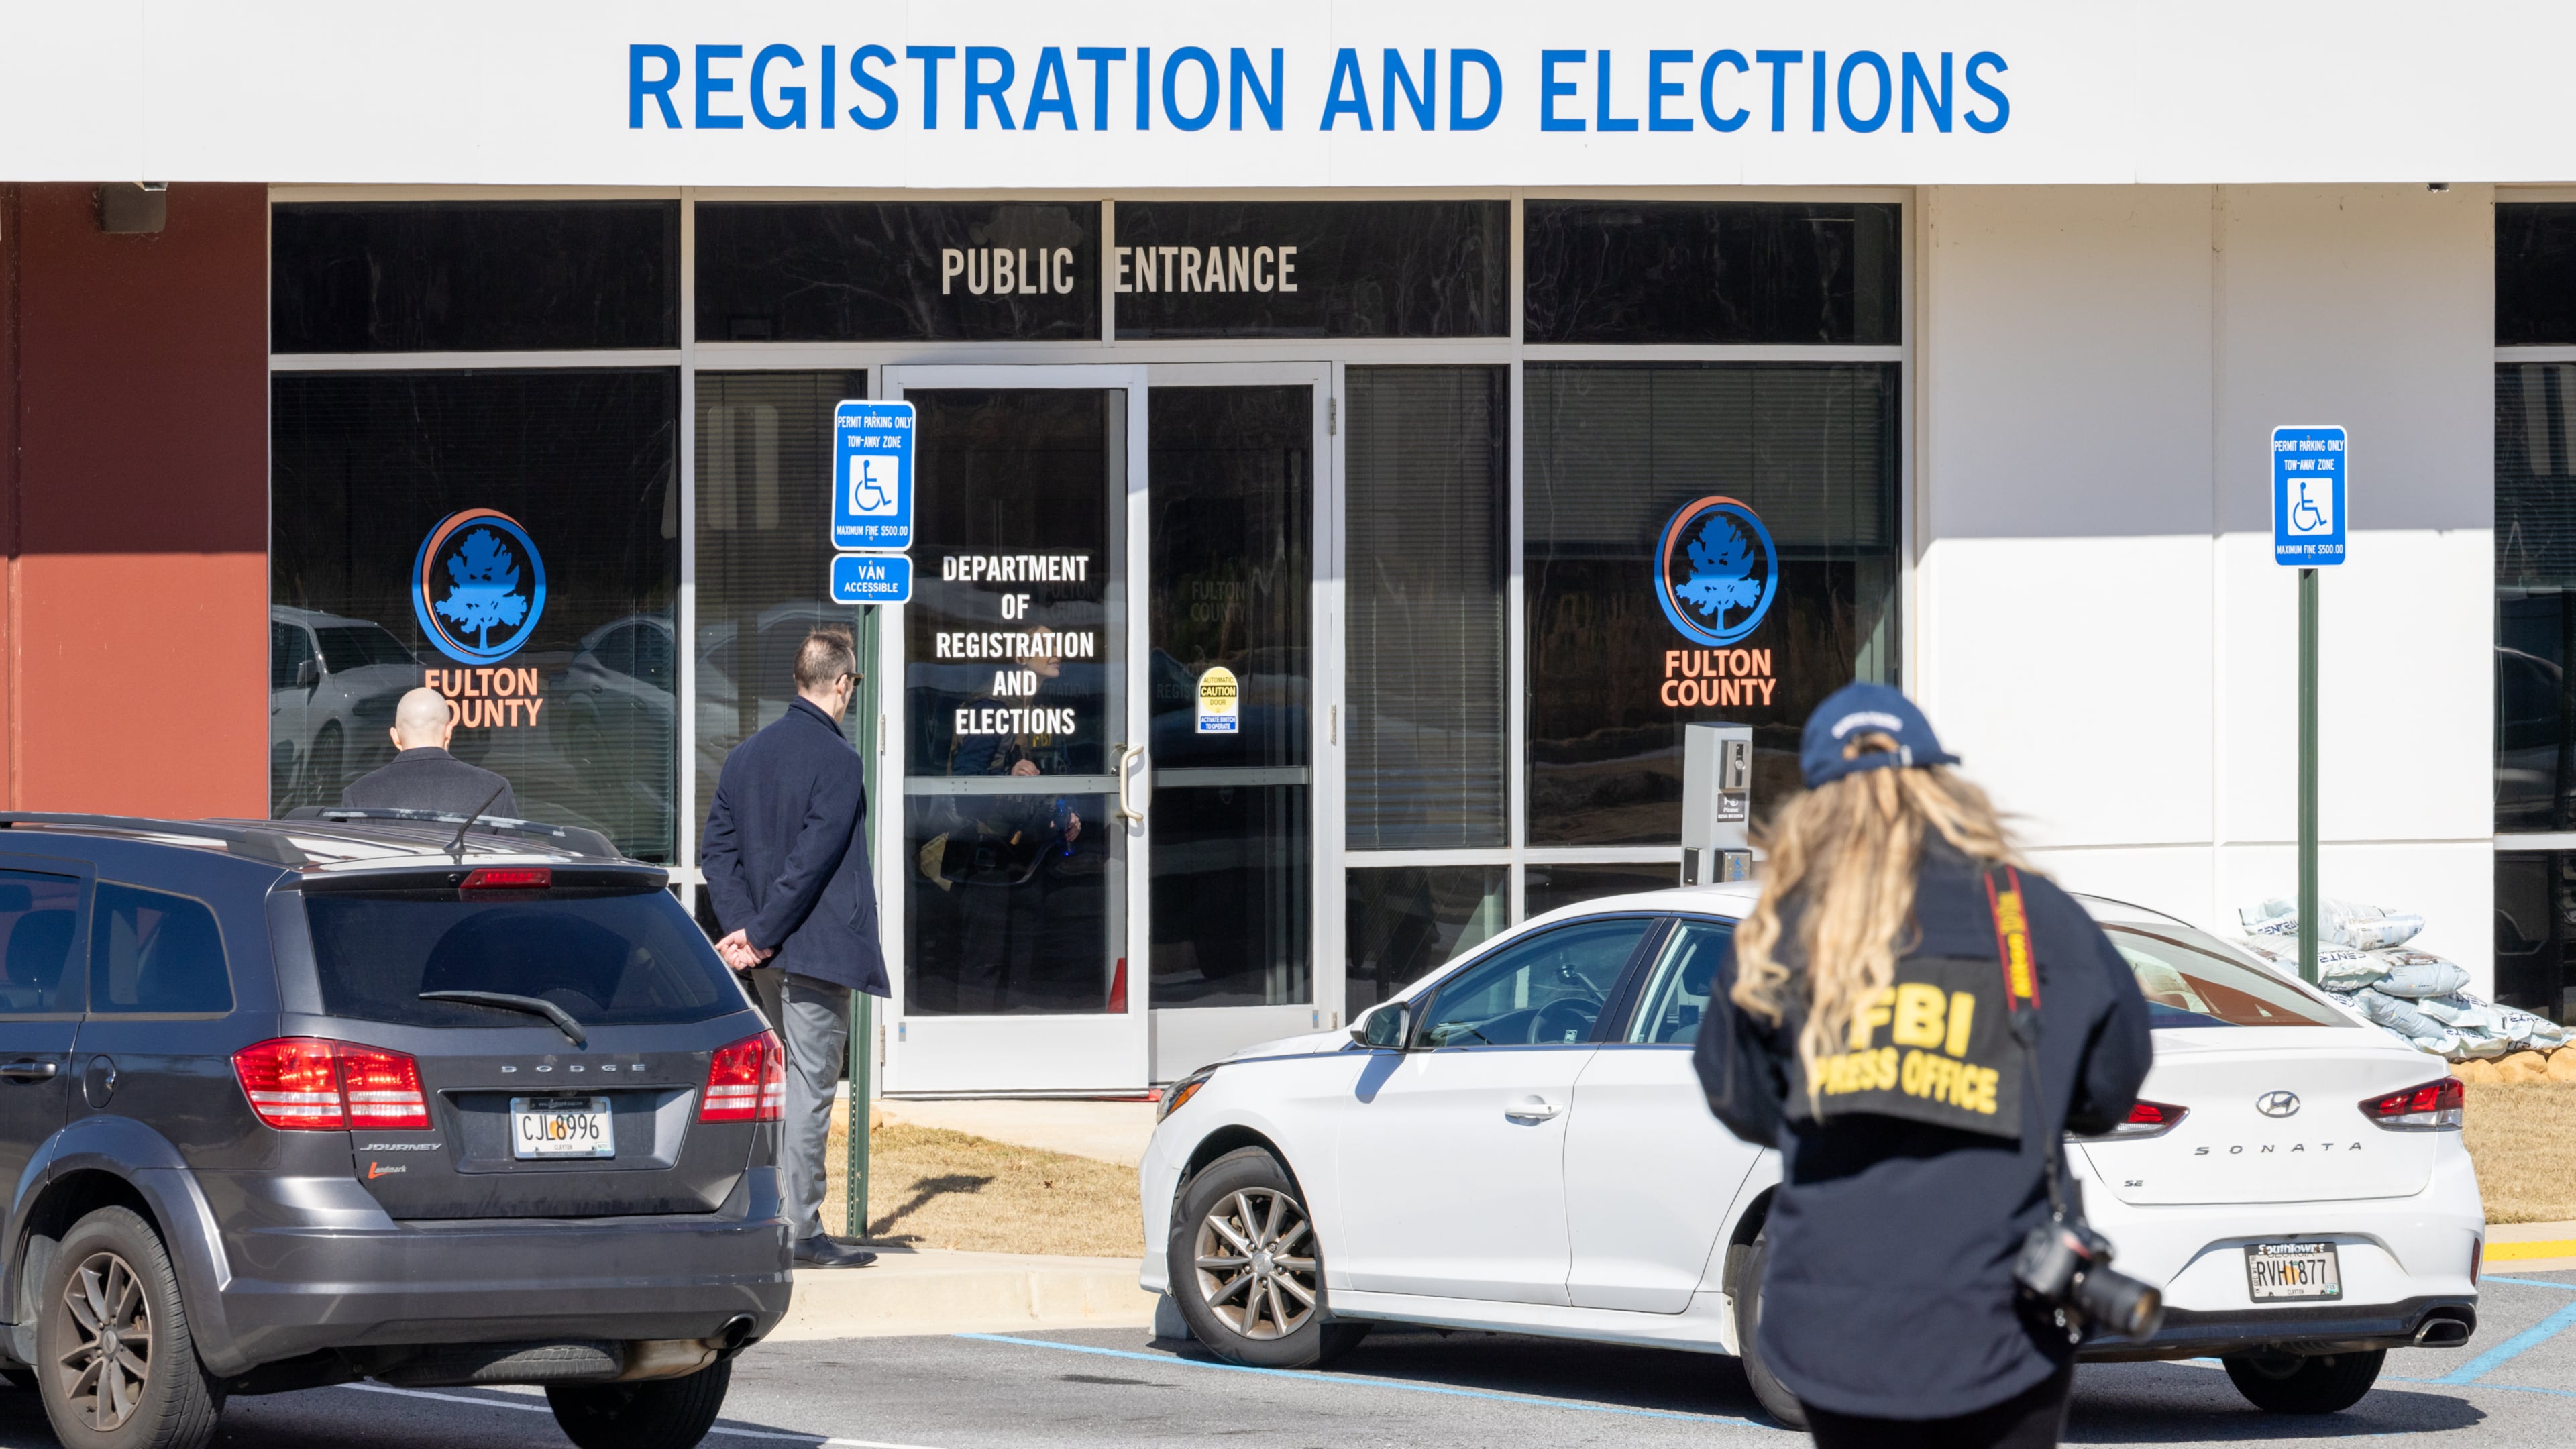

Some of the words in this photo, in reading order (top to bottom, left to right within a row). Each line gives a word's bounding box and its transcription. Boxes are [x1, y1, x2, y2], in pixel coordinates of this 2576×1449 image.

[629, 43, 1284, 132] REGISTRATION
[1320, 47, 1503, 132] AND
[1540, 48, 2011, 135] ELECTIONS
[941, 247, 1074, 296] PUBLIC
[1114, 246, 1298, 293] ENTRANCE
[837, 416, 862, 429] PERMIT
[863, 416, 892, 429] PARKING
[895, 416, 912, 429] ONLY
[847, 435, 881, 448] TOW-AWAY
[883, 435, 902, 448] ZONE
[2274, 440, 2298, 452] PERMIT
[2299, 440, 2326, 452] PARKING
[2327, 439, 2345, 451] ONLY
[2284, 459, 2316, 471] TOW-AWAY
[2318, 458, 2335, 470] ZONE
[836, 525, 863, 536] MAXIMUM
[865, 525, 879, 536] FINE
[881, 525, 908, 537] $500.00
[2277, 545, 2302, 555] MAXIMUM
[2304, 545, 2316, 555] FINE
[2318, 544, 2343, 555] $500.00
[858, 566, 885, 580] VAN
[943, 555, 1089, 582] DEPARTMENT
[844, 582, 898, 593] ACCESSIBLE
[1002, 594, 1030, 620] OF
[936, 631, 1094, 658] REGISTRATION
[1664, 649, 1771, 678] FULTON
[424, 667, 538, 697] FULTON
[992, 669, 1037, 696] AND
[1201, 686, 1236, 696] CAUTION
[1660, 678, 1777, 707] COUNTY
[445, 698, 544, 728] OUNTY
[955, 708, 1075, 735] ELECTIONS
[2318, 953, 2367, 964] CENTR
[1850, 982, 1976, 1058] FBI
[502, 1063, 646, 1073] DODGE
[1808, 1046, 1899, 1097] PRESS
[1901, 1049, 2000, 1115] OFFICE
[523, 1114, 600, 1141] CJL8996
[359, 1143, 443, 1152] JOURNEY
[2194, 1141, 2363, 1155] SONATA
[367, 1161, 407, 1180] Landmark
[2257, 1259, 2326, 1287] RVH1877
